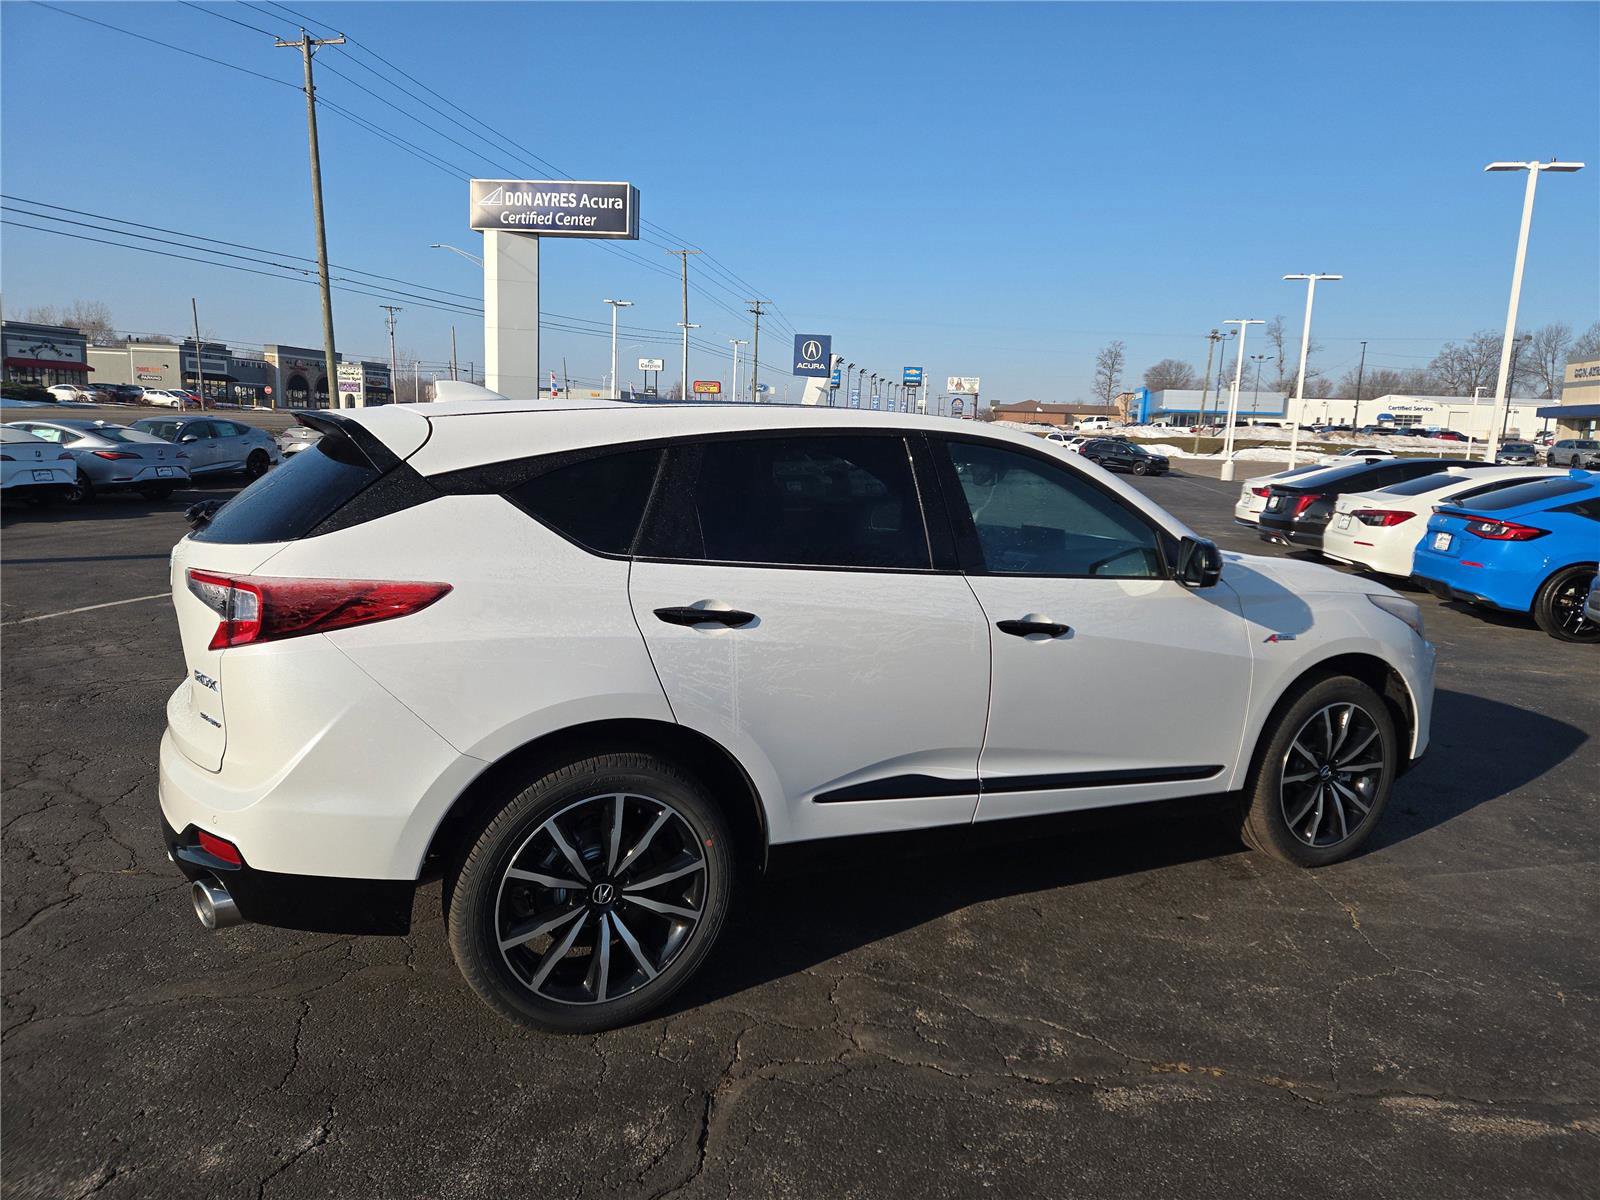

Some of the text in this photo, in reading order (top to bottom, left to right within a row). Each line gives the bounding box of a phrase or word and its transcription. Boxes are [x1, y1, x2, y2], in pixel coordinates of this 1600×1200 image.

[505, 191, 623, 209] DON AYRES Acura
[500, 210, 596, 226] Certified Center
[796, 362, 826, 370] ACURA
